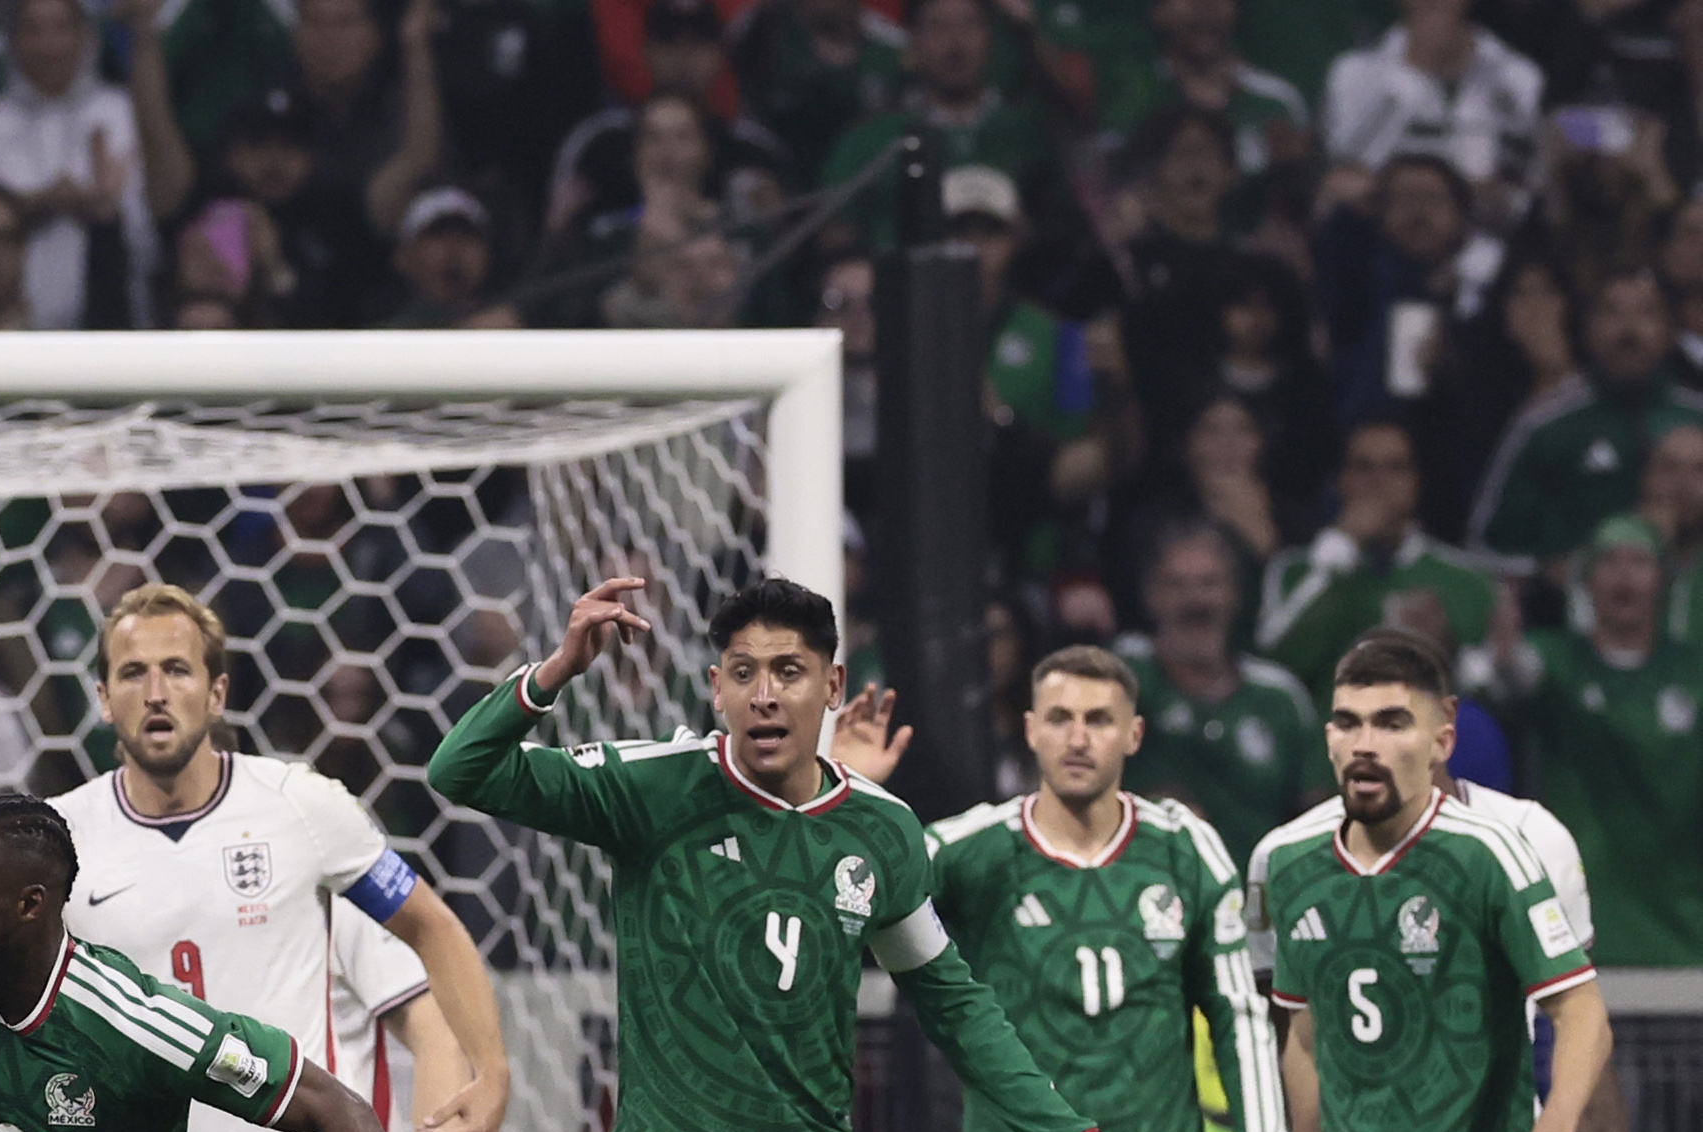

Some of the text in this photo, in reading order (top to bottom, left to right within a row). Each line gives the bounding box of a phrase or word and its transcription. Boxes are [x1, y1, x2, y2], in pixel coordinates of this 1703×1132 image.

[171, 940, 206, 1001] 9
[765, 911, 802, 991] 4
[1075, 946, 1126, 1016] 11
[1348, 968, 1384, 1042] 5
[49, 1114, 94, 1125] MÉXICO
